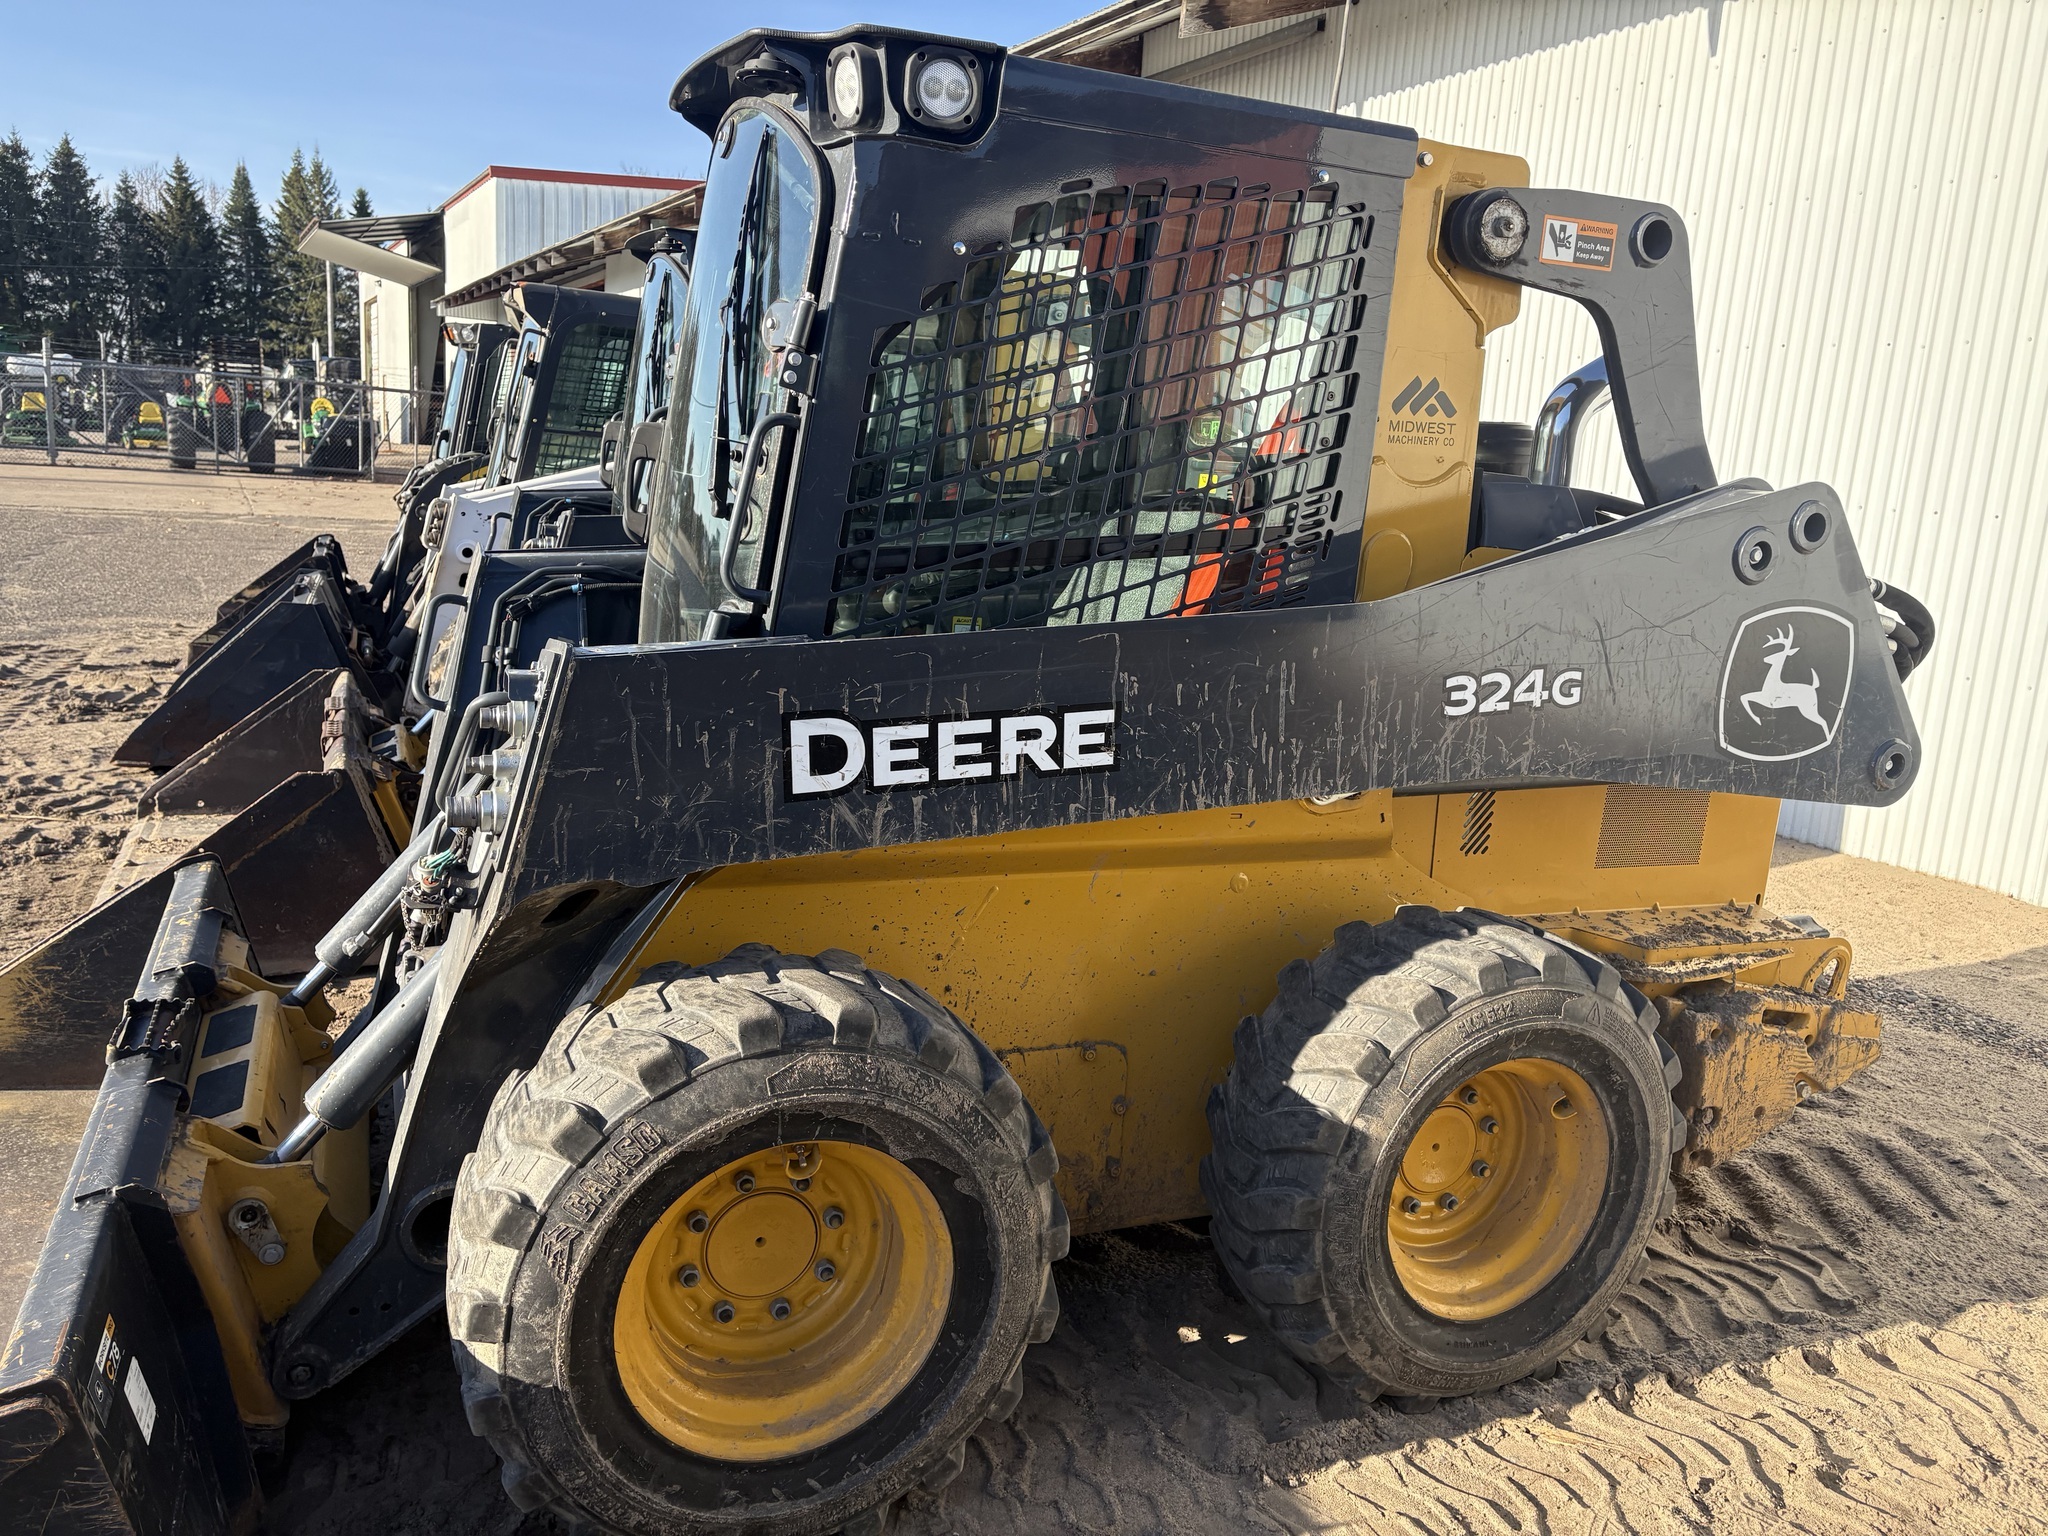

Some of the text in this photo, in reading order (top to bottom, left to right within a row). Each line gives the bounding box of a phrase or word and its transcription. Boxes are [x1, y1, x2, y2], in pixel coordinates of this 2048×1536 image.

[1586, 225, 1613, 235] WARNING
[1577, 241, 1610, 252] Pinch Area
[1576, 251, 1604, 262] Keep Away
[1388, 420, 1457, 435] MIDWEST
[1387, 434, 1455, 446] MACHINERY CO
[1444, 669, 1583, 716] 324G
[790, 709, 1115, 794] DEERE
[563, 1120, 661, 1222] CAMSO
[106, 1341, 120, 1380] C78
